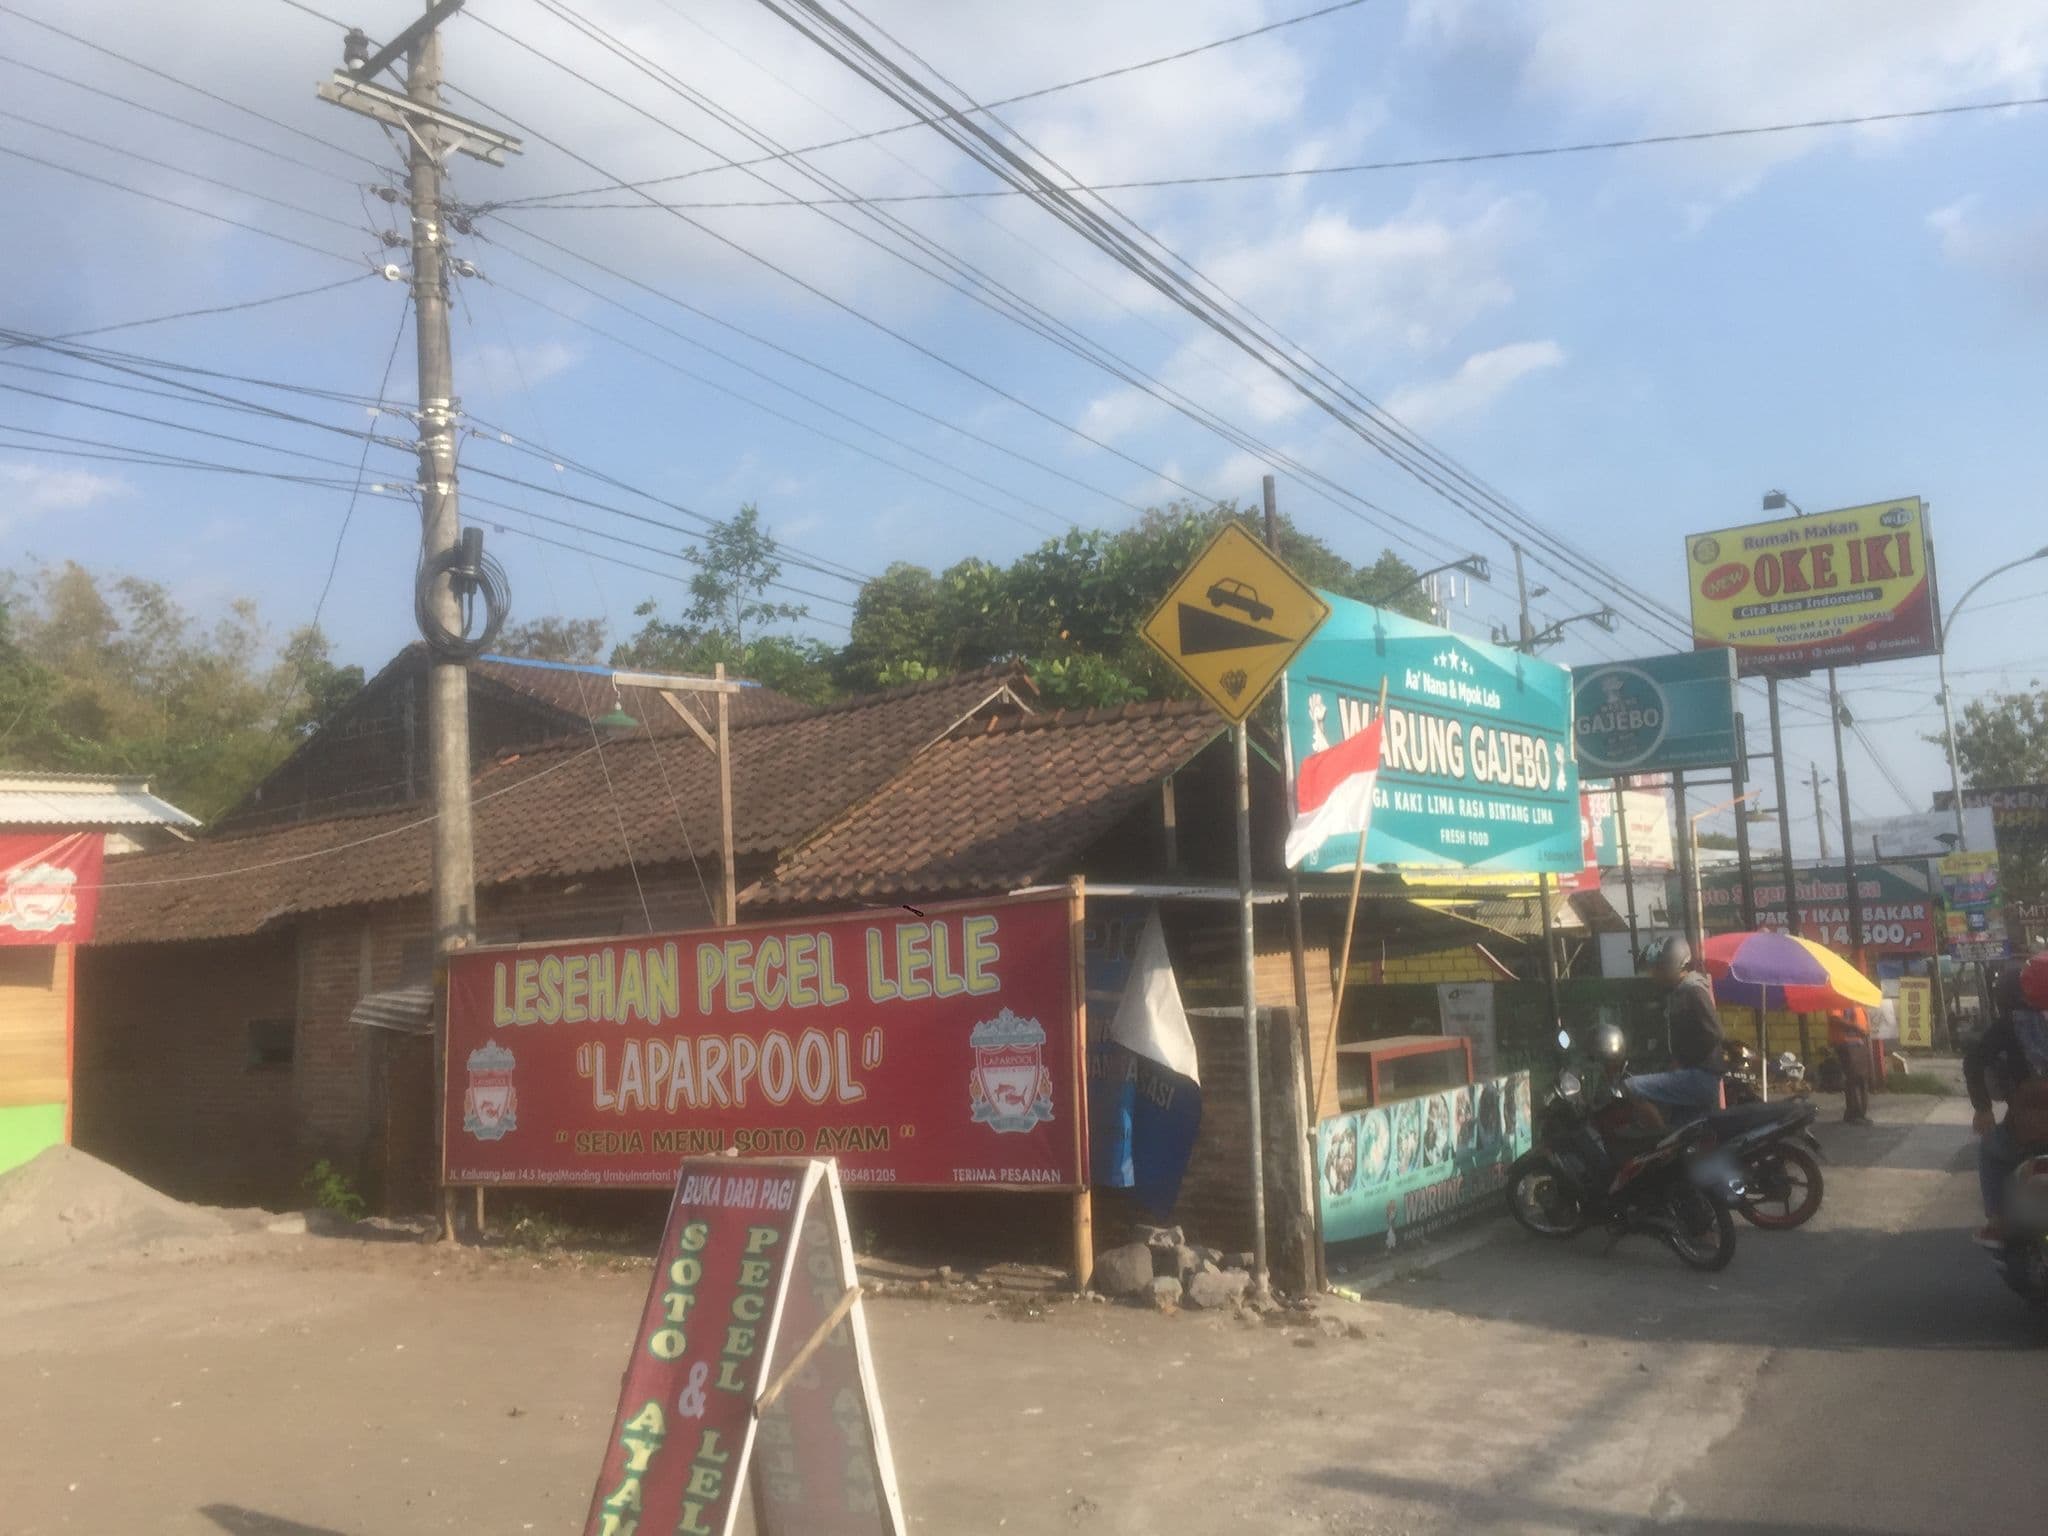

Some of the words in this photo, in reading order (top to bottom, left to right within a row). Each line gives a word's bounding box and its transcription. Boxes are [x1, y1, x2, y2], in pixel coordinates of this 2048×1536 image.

[1743, 530, 1800, 550] Rumah
[1804, 520, 1859, 540] Makan
[1754, 543, 1838, 597] OKE
[1847, 532, 1914, 584] IKI
[1740, 605, 1767, 618] Cita
[1770, 601, 1801, 614] Rasa
[1806, 591, 1875, 608] Indonesia
[1423, 672, 1448, 697] Nana
[1576, 708, 1660, 735] GAJEBO
[1469, 724, 1552, 791] GAJEBO
[1395, 790, 1424, 813] KAKI
[1427, 794, 1455, 816] LIMA
[1459, 797, 1485, 819] RASA
[1489, 801, 1530, 824] BINTANG
[1532, 807, 1554, 825] LIMA
[1440, 828, 1466, 844] FRESH
[1468, 830, 1490, 847] FOOD
[1755, 909, 1808, 925] PAKT
[1862, 904, 1925, 922] BAKAR
[493, 942, 680, 1027] LESEHAN
[697, 931, 850, 1015] PECEL
[865, 914, 1001, 1003] LELE
[574, 1129, 645, 1154] SEDIA
[652, 1128, 728, 1152] MENU
[733, 1127, 807, 1152] SOTO
[813, 1125, 891, 1151] AYAM
[953, 1168, 997, 1182] TERIMA
[1000, 1168, 1062, 1183] PESANAN
[681, 1175, 721, 1206] BUKA
[722, 1176, 759, 1209] DARI
[760, 1178, 796, 1210] PAGI
[649, 1221, 709, 1360] SOTO
[714, 1226, 779, 1393] PECEL
